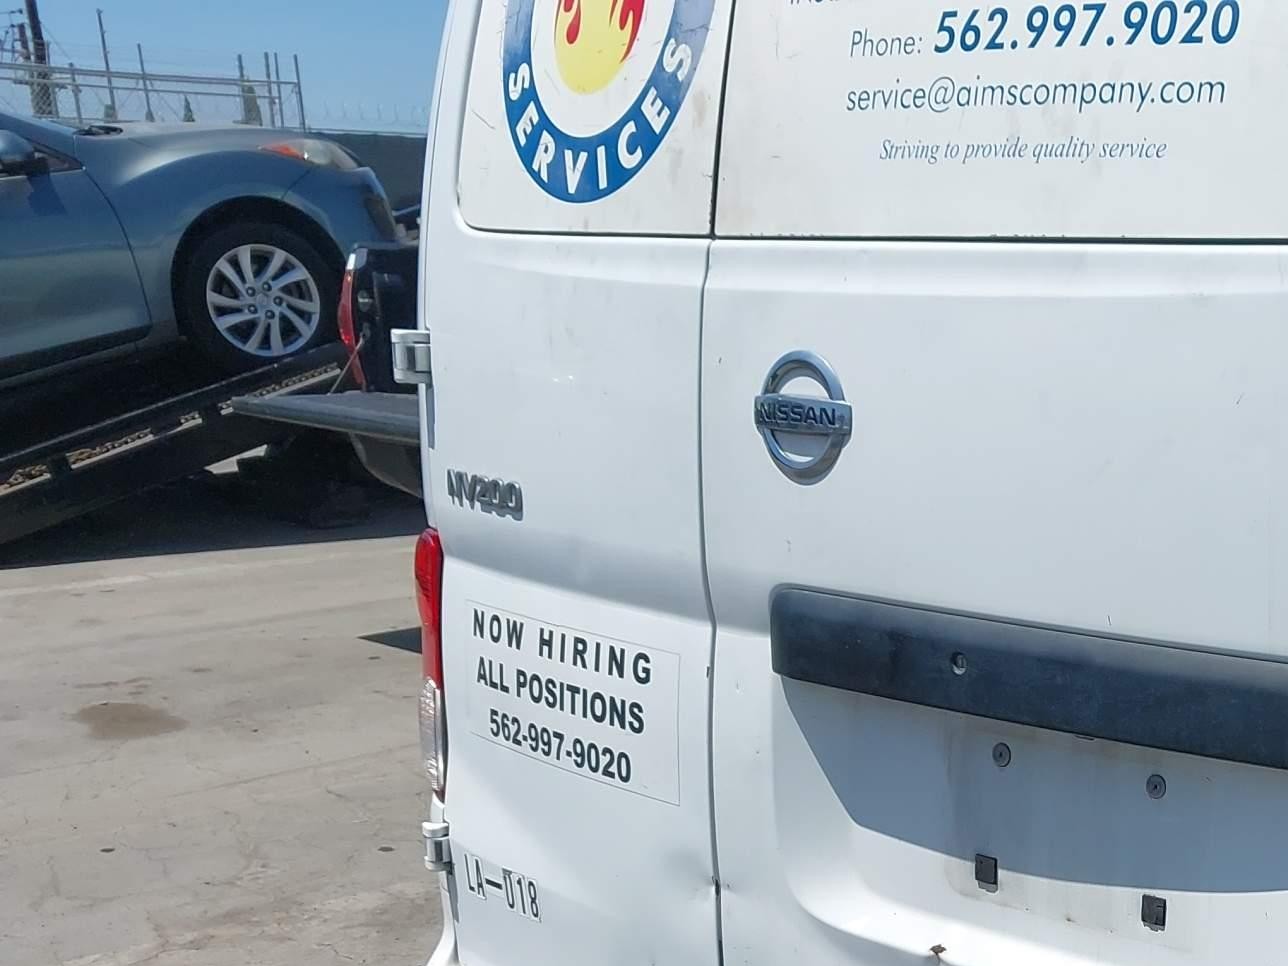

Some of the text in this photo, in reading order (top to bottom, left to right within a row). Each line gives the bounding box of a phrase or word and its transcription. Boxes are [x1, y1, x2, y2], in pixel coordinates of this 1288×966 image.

[850, 0, 1240, 57] Phone: 562.997.9020
[507, 37, 694, 195] SERVICES
[846, 75, 1226, 114] service@aimscompany.com
[879, 136, 1168, 165] Striving to provide quality service
[759, 401, 837, 426] NISSAN
[472, 607, 652, 685] NOW HIRING
[476, 656, 645, 734] ALL POSITIONS
[489, 707, 632, 784] 562-997-9020
